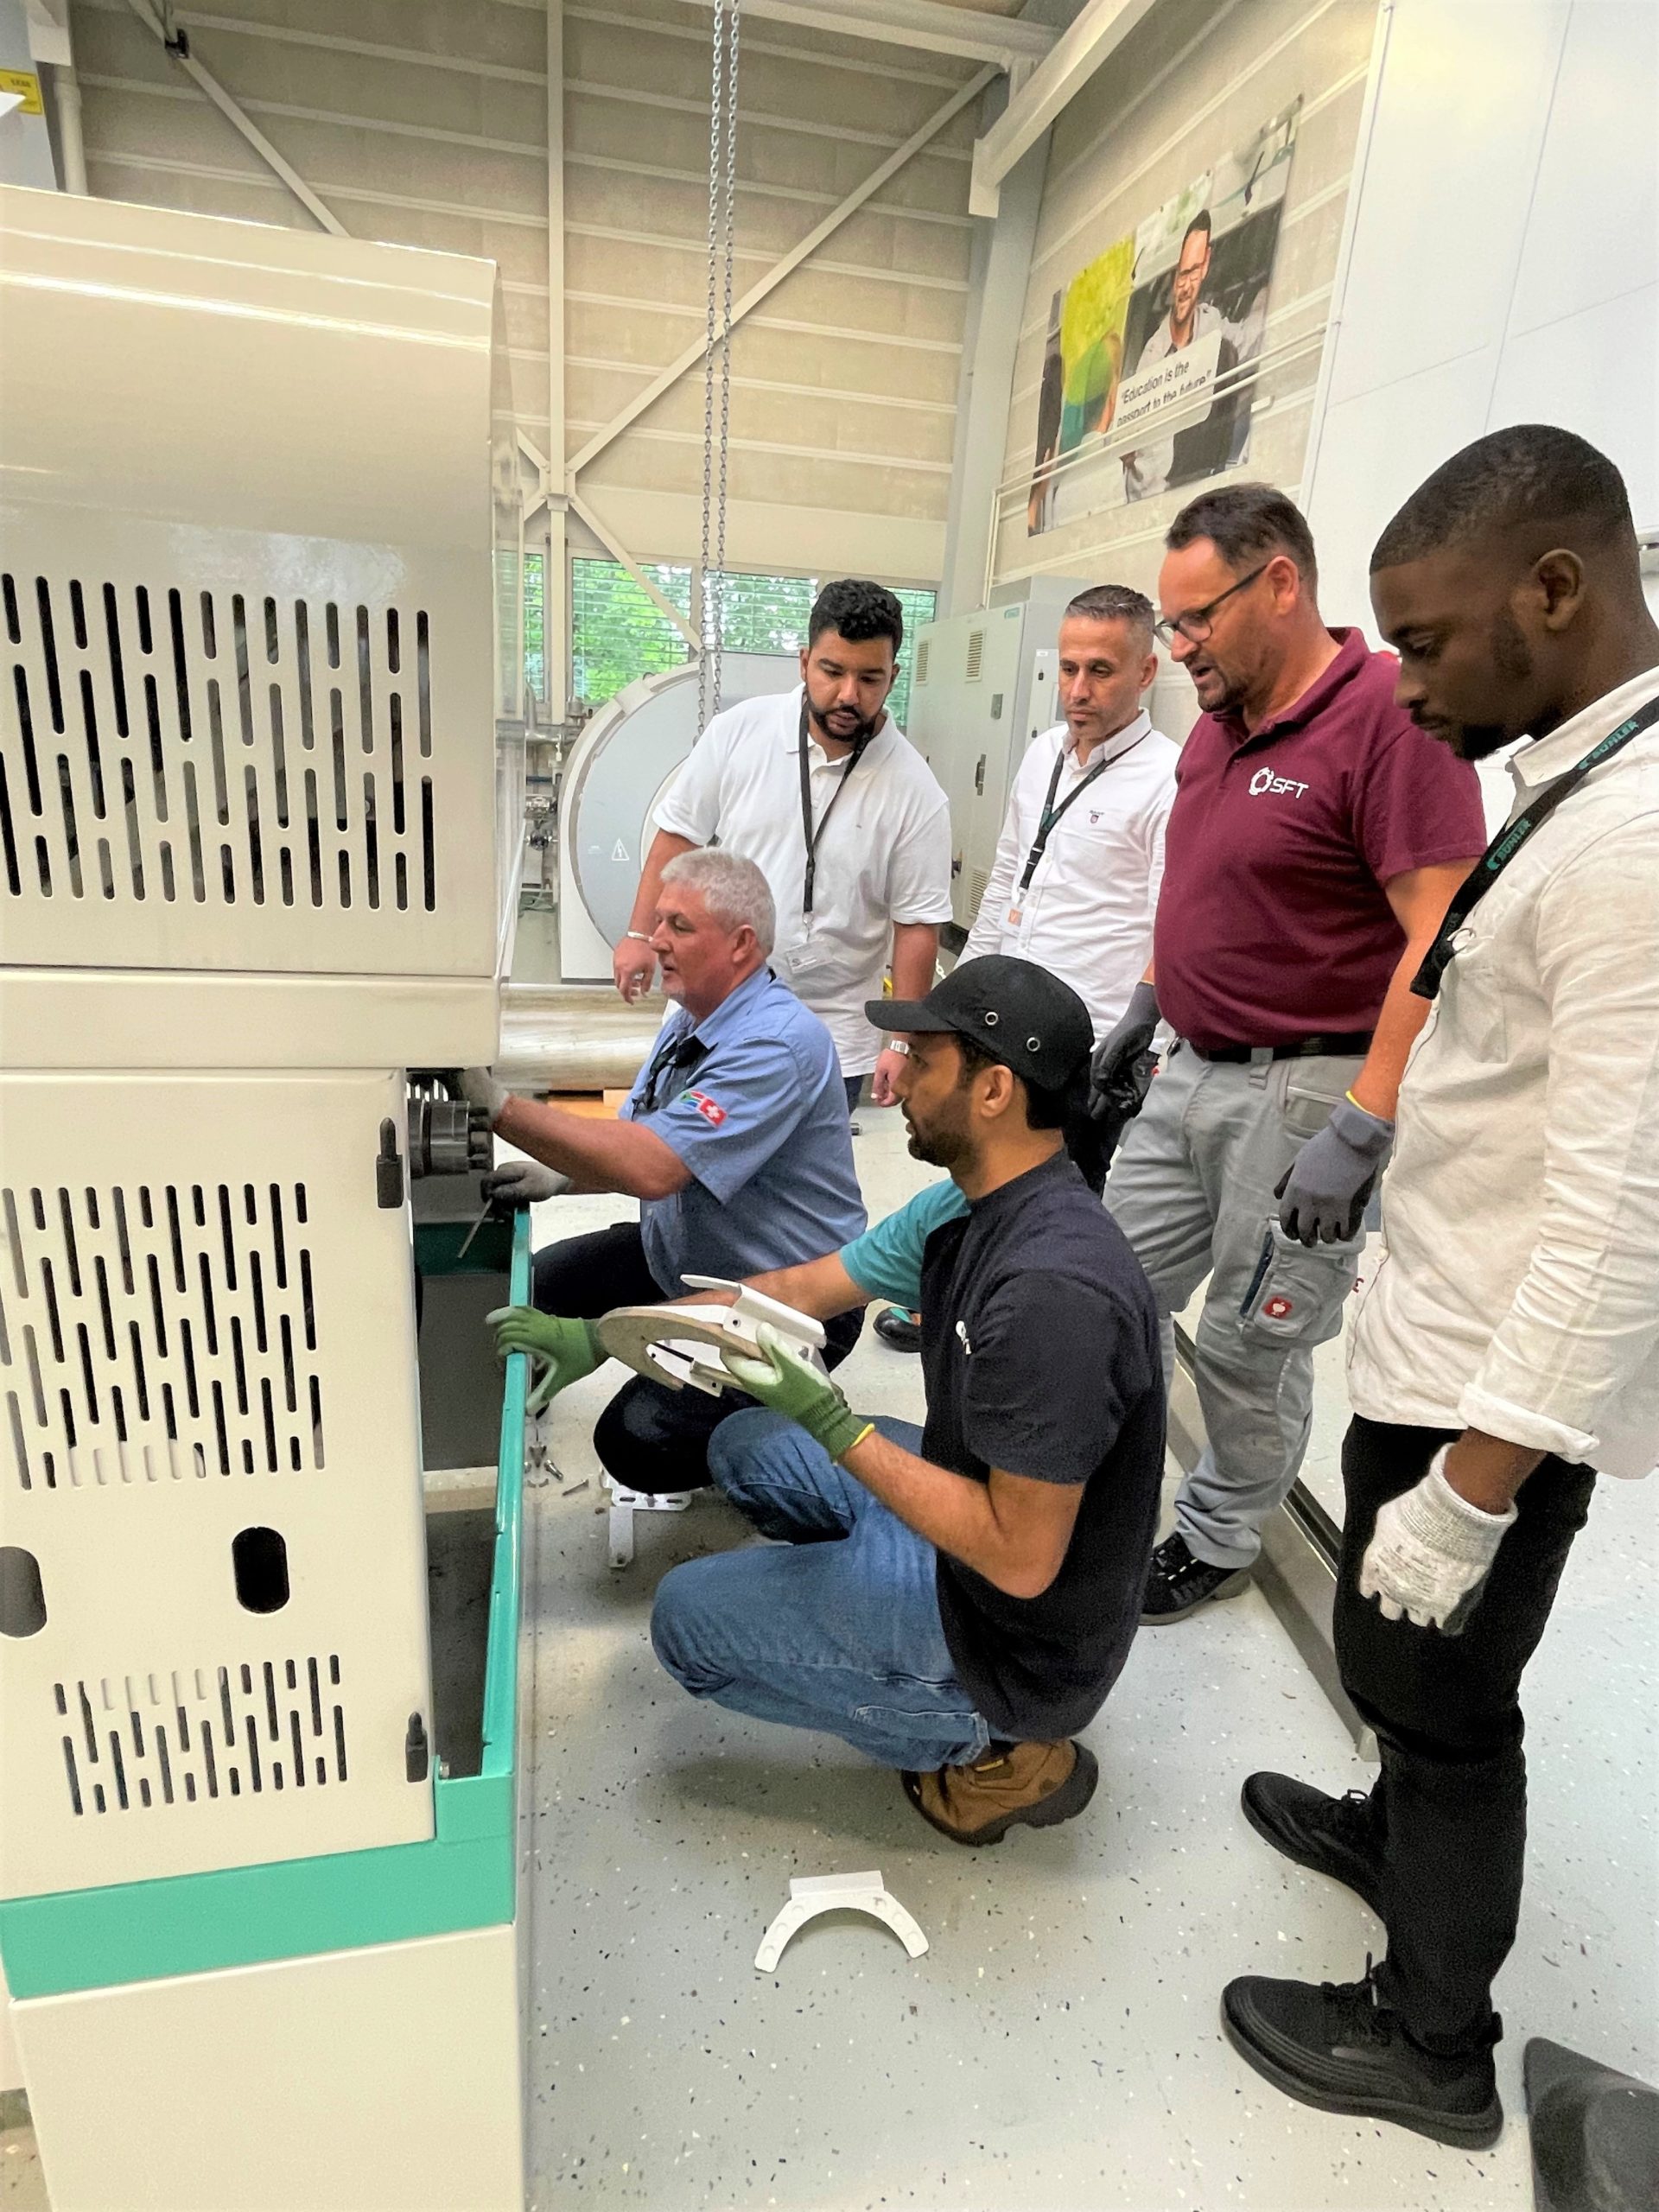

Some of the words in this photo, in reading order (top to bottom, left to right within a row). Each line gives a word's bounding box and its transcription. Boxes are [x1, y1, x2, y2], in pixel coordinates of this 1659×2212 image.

[1165, 368, 1173, 382] is
[1175, 361, 1189, 378] the
[1163, 391, 1177, 404] the
